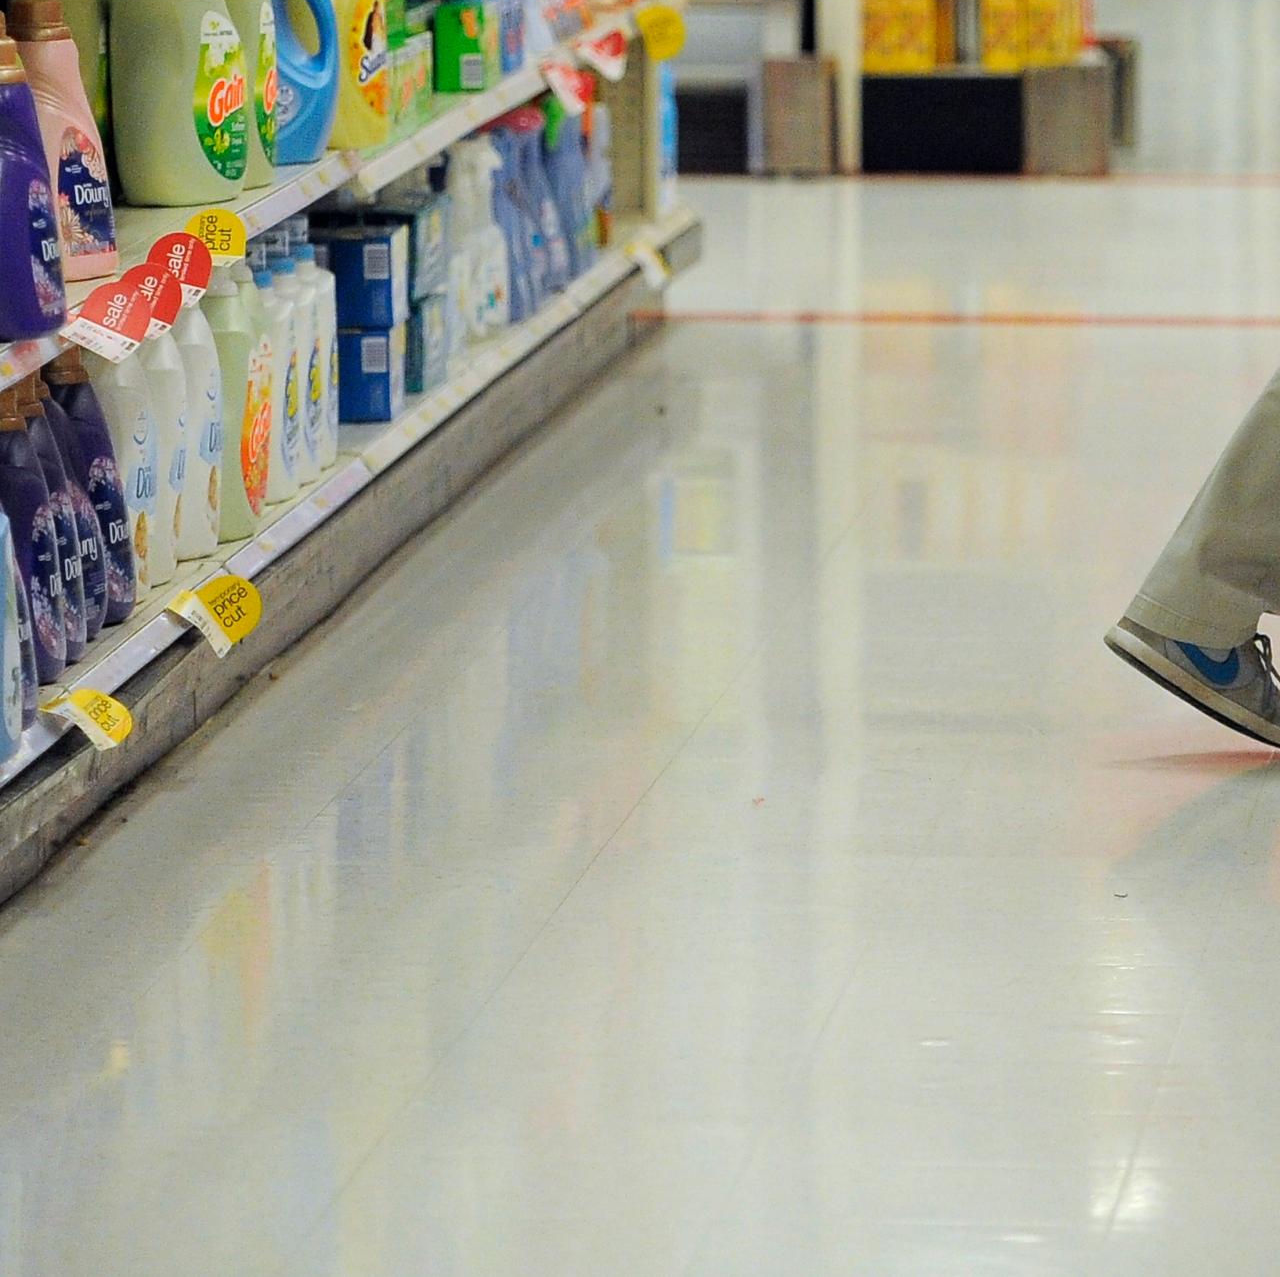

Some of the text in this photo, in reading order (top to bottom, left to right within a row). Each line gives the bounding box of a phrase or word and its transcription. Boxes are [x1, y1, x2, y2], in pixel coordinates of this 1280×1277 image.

[207, 72, 247, 127] Gain
[74, 184, 109, 208] Downy
[205, 215, 218, 251] price
[219, 227, 232, 252] cut
[102, 293, 128, 328] sale
[212, 585, 249, 619] price
[222, 605, 248, 629] cut
